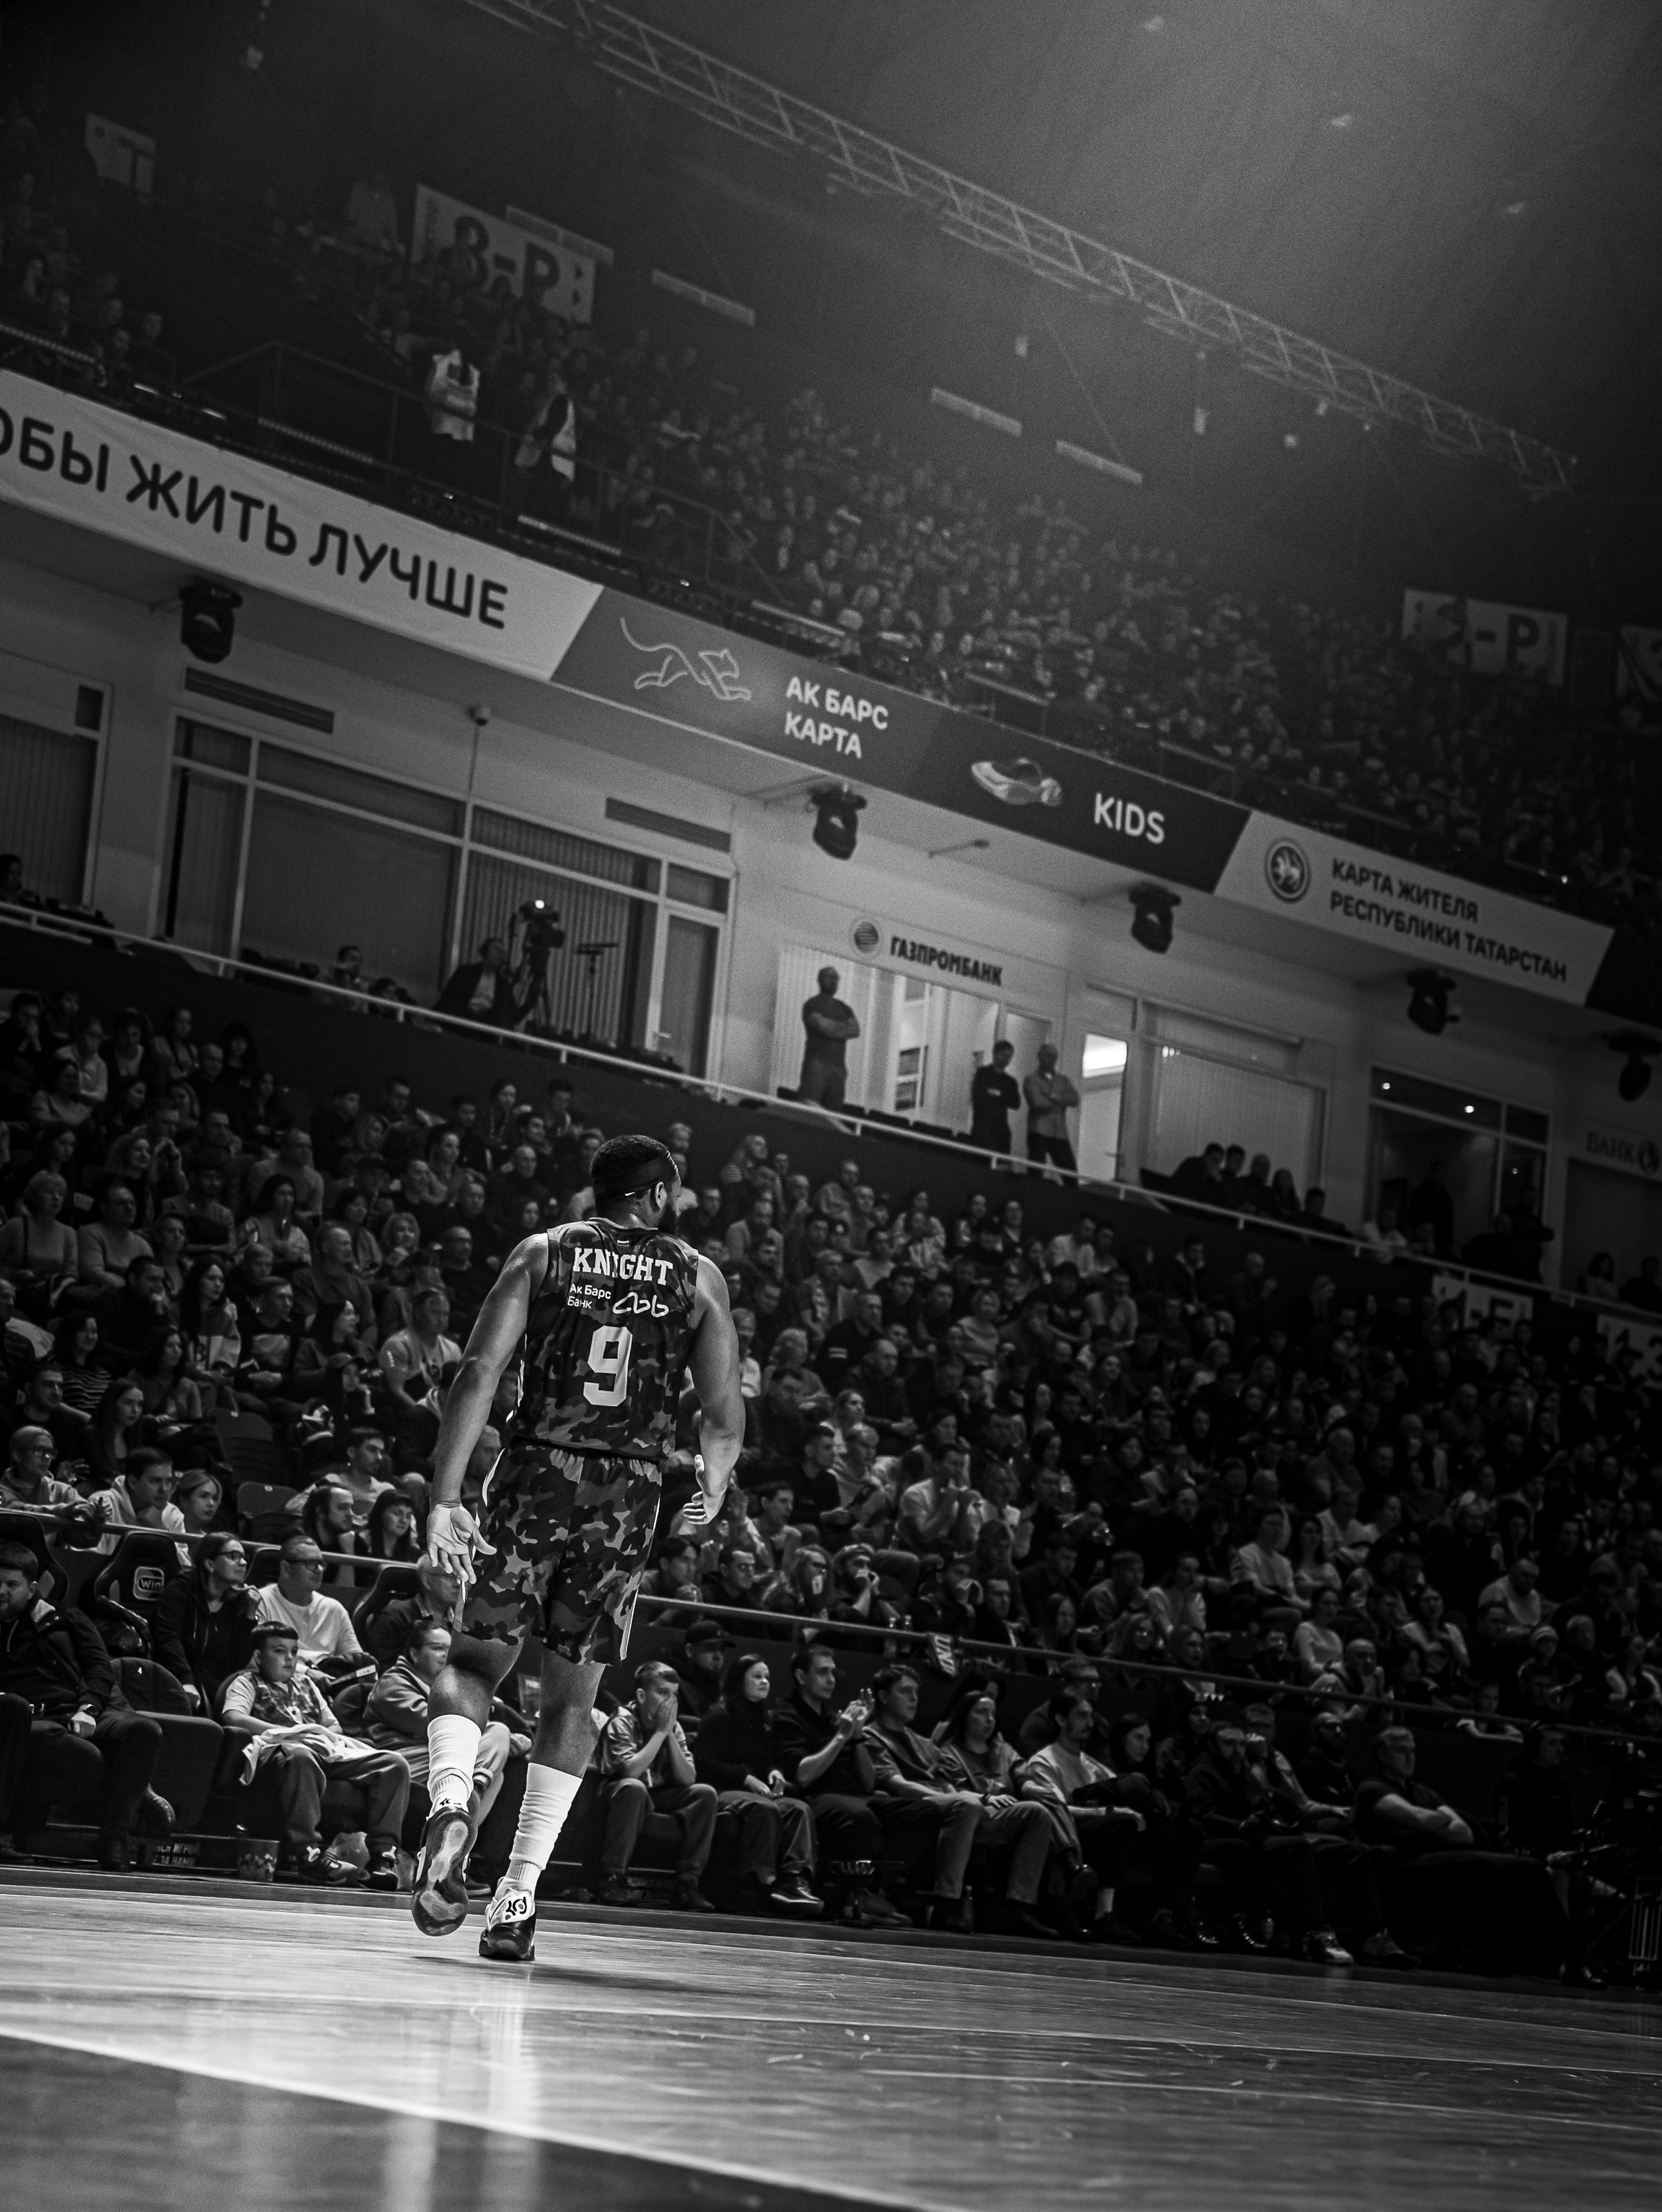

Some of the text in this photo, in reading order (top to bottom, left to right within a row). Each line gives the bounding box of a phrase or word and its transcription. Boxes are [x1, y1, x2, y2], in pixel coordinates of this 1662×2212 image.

[126, 455, 297, 556] ЖИТЬ
[308, 523, 508, 630] ЛУЧШЕ
[786, 676, 889, 730] АК БАРС
[784, 710, 862, 759] КАРТА
[1094, 791, 1165, 844] KIDS
[1332, 858, 1479, 923] КАРТА ЖИТЕЛЯ
[890, 936, 1002, 987] ГАЗПРОМБАНК
[1329, 891, 1567, 982] РЕСПУБЛИКИ ТАТАРСТАН
[1587, 1132, 1635, 1164] БАНК
[569, 1283, 612, 1300] Ак Барс
[573, 1247, 673, 1286] KNIGHT
[567, 1295, 592, 1309] Банк
[583, 1325, 633, 1407] 9
